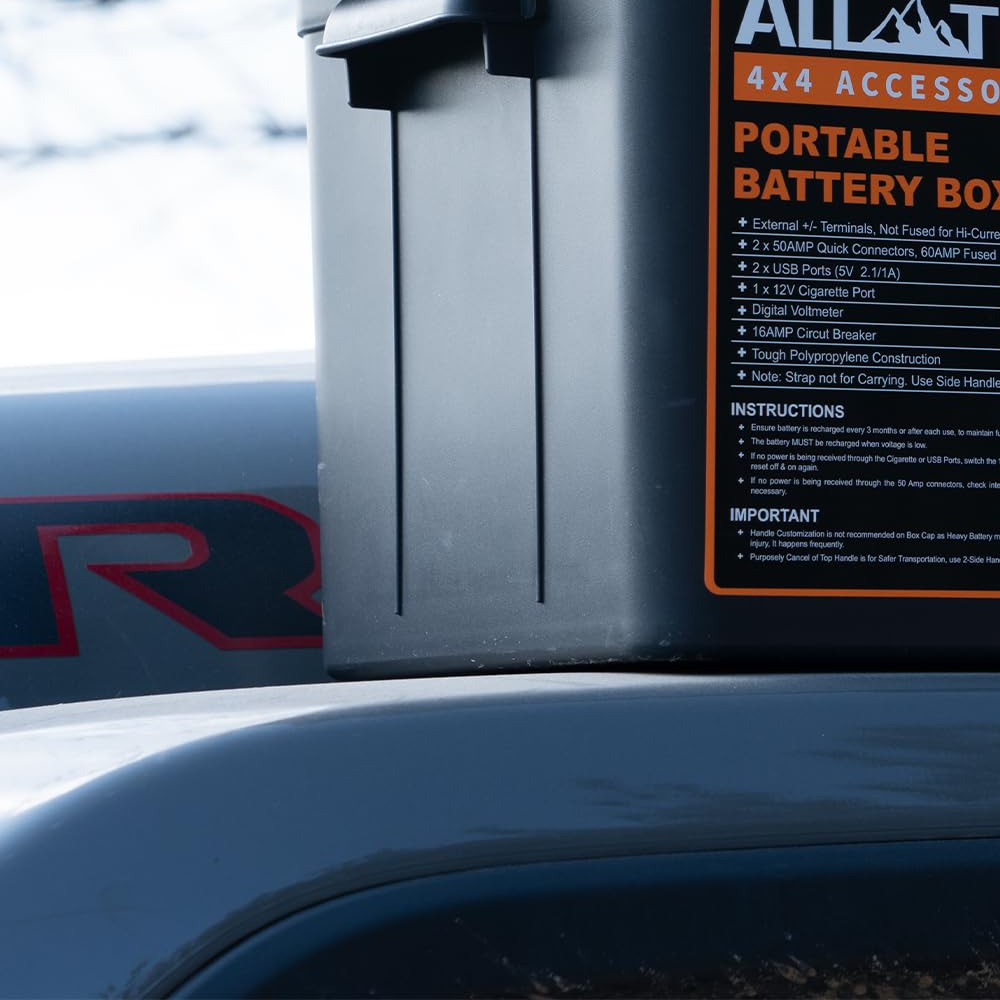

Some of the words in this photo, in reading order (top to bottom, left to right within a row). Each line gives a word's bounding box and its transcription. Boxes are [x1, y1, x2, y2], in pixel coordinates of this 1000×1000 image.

[746, 65, 812, 93] 4x4
[734, 121, 949, 164] PORTABLE
[734, 167, 921, 207] BATTERY
[753, 218, 798, 231] External
[802, 220, 817, 231] +/-
[820, 221, 875, 235] Terminals,
[879, 223, 898, 235] Not
[902, 224, 935, 236] Fused
[938, 225, 953, 237] for
[752, 239, 759, 251] 2
[763, 242, 769, 251] x
[772, 240, 813, 253] 50AMP
[816, 242, 848, 254] Quick
[851, 243, 917, 258] Connectors,
[920, 246, 960, 259] 60AMP
[963, 247, 996, 260] Fused
[752, 262, 759, 273] 2
[762, 264, 769, 273] x
[773, 262, 798, 274] USB
[802, 263, 831, 276] Ports
[834, 265, 853, 279] (5V
[860, 266, 900, 279] 2.1/1A)
[753, 283, 757, 295] 1
[762, 286, 769, 295] x
[773, 284, 795, 296] 12V
[798, 285, 848, 300] Cigarette
[852, 286, 875, 298] Port
[752, 304, 787, 318] Digital
[790, 305, 843, 316] Voltmeter
[752, 326, 793, 338] 16AMP
[796, 327, 829, 339] Circut
[832, 328, 876, 340] Breaker
[751, 349, 785, 363] Tough
[790, 349, 868, 365] Polypropylene
[872, 351, 940, 364] Construction
[751, 370, 781, 382] Note:
[785, 371, 815, 386] Strap
[819, 372, 836, 383] not
[839, 372, 854, 384] for
[857, 373, 907, 388] Carrying.
[911, 374, 933, 386] Use
[936, 375, 960, 387] Side
[731, 402, 844, 417] INSTRUCTIONS
[777, 424, 801, 434] battery
[810, 425, 844, 435] recharged
[845, 427, 865, 435] every
[866, 426, 871, 434] 3
[872, 426, 897, 434] months
[907, 427, 923, 435] after
[957, 428, 964, 436] to
[766, 438, 790, 448] battery
[791, 438, 813, 446] MUST
[825, 439, 859, 449] recharged
[880, 440, 905, 450] voltage
[766, 454, 788, 462] power
[796, 453, 816, 463] being
[847, 454, 873, 464] through
[886, 455, 917, 465] Cigarette
[779, 463, 785, 471] &
[769, 479, 791, 487] power
[802, 478, 821, 487] being
[823, 478, 853, 486] received
[855, 479, 881, 488] through
[897, 479, 906, 487] 50
[907, 480, 923, 489] Amp
[730, 508, 819, 522] IMPORTANT
[750, 529, 774, 537] Handle
[776, 530, 824, 538] Customization
[834, 530, 845, 538] not
[906, 531, 919, 539] Box
[920, 532, 935, 541] Cap
[946, 532, 967, 541] Heavy
[968, 532, 992, 542] Battery
[778, 540, 808, 549] happens
[749, 553, 784, 563] Purposely
[819, 554, 832, 563] Top
[834, 554, 858, 562] Handle
[867, 554, 876, 562] for
[962, 555, 984, 563] 2-Side
